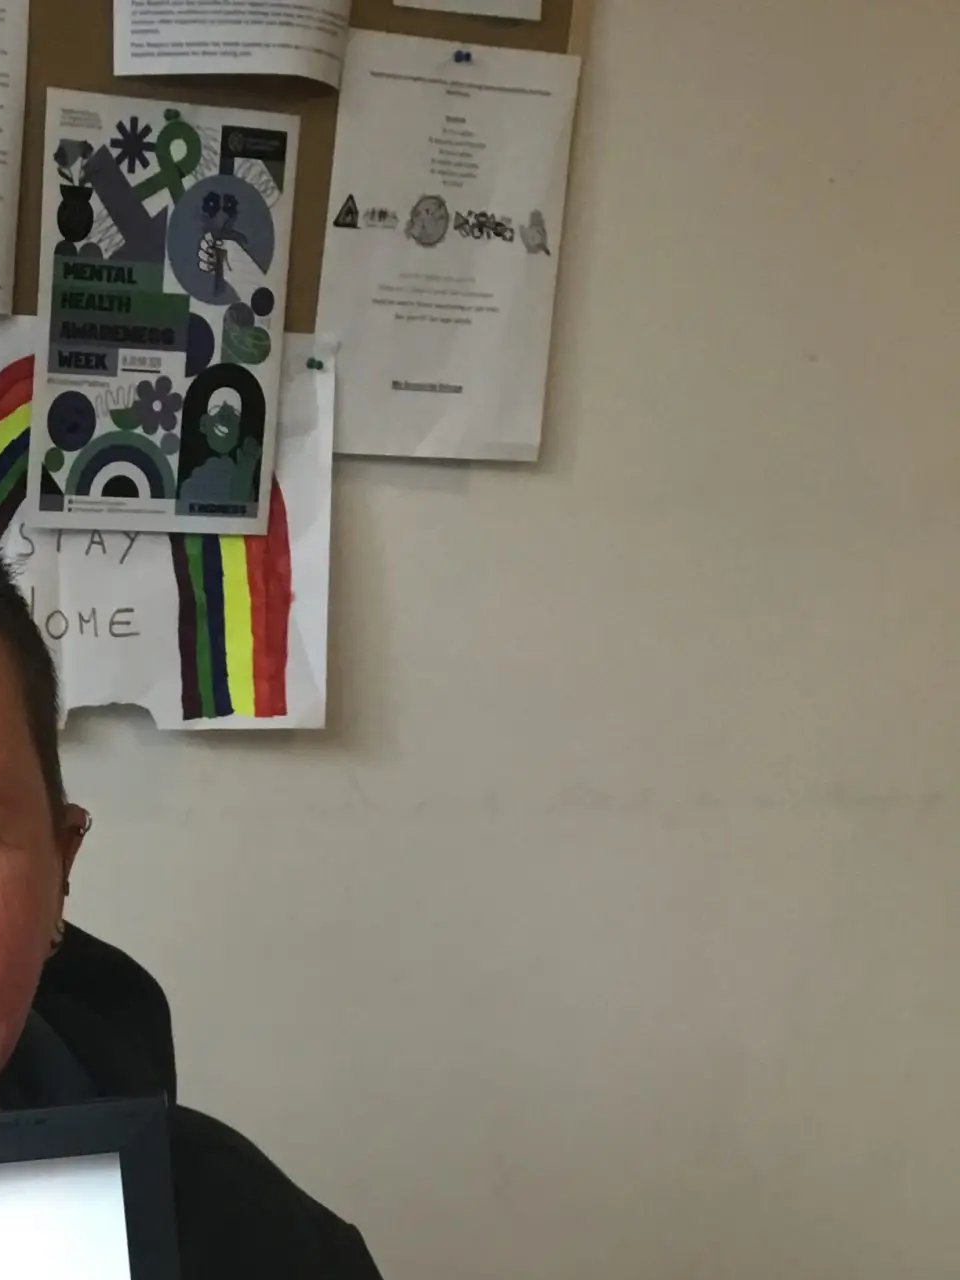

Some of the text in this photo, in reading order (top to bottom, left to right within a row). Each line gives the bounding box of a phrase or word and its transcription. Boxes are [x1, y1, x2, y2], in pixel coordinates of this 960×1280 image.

[63, 261, 138, 284] MENTAL
[61, 291, 132, 313] HEALTH
[57, 349, 108, 371] WEEK
